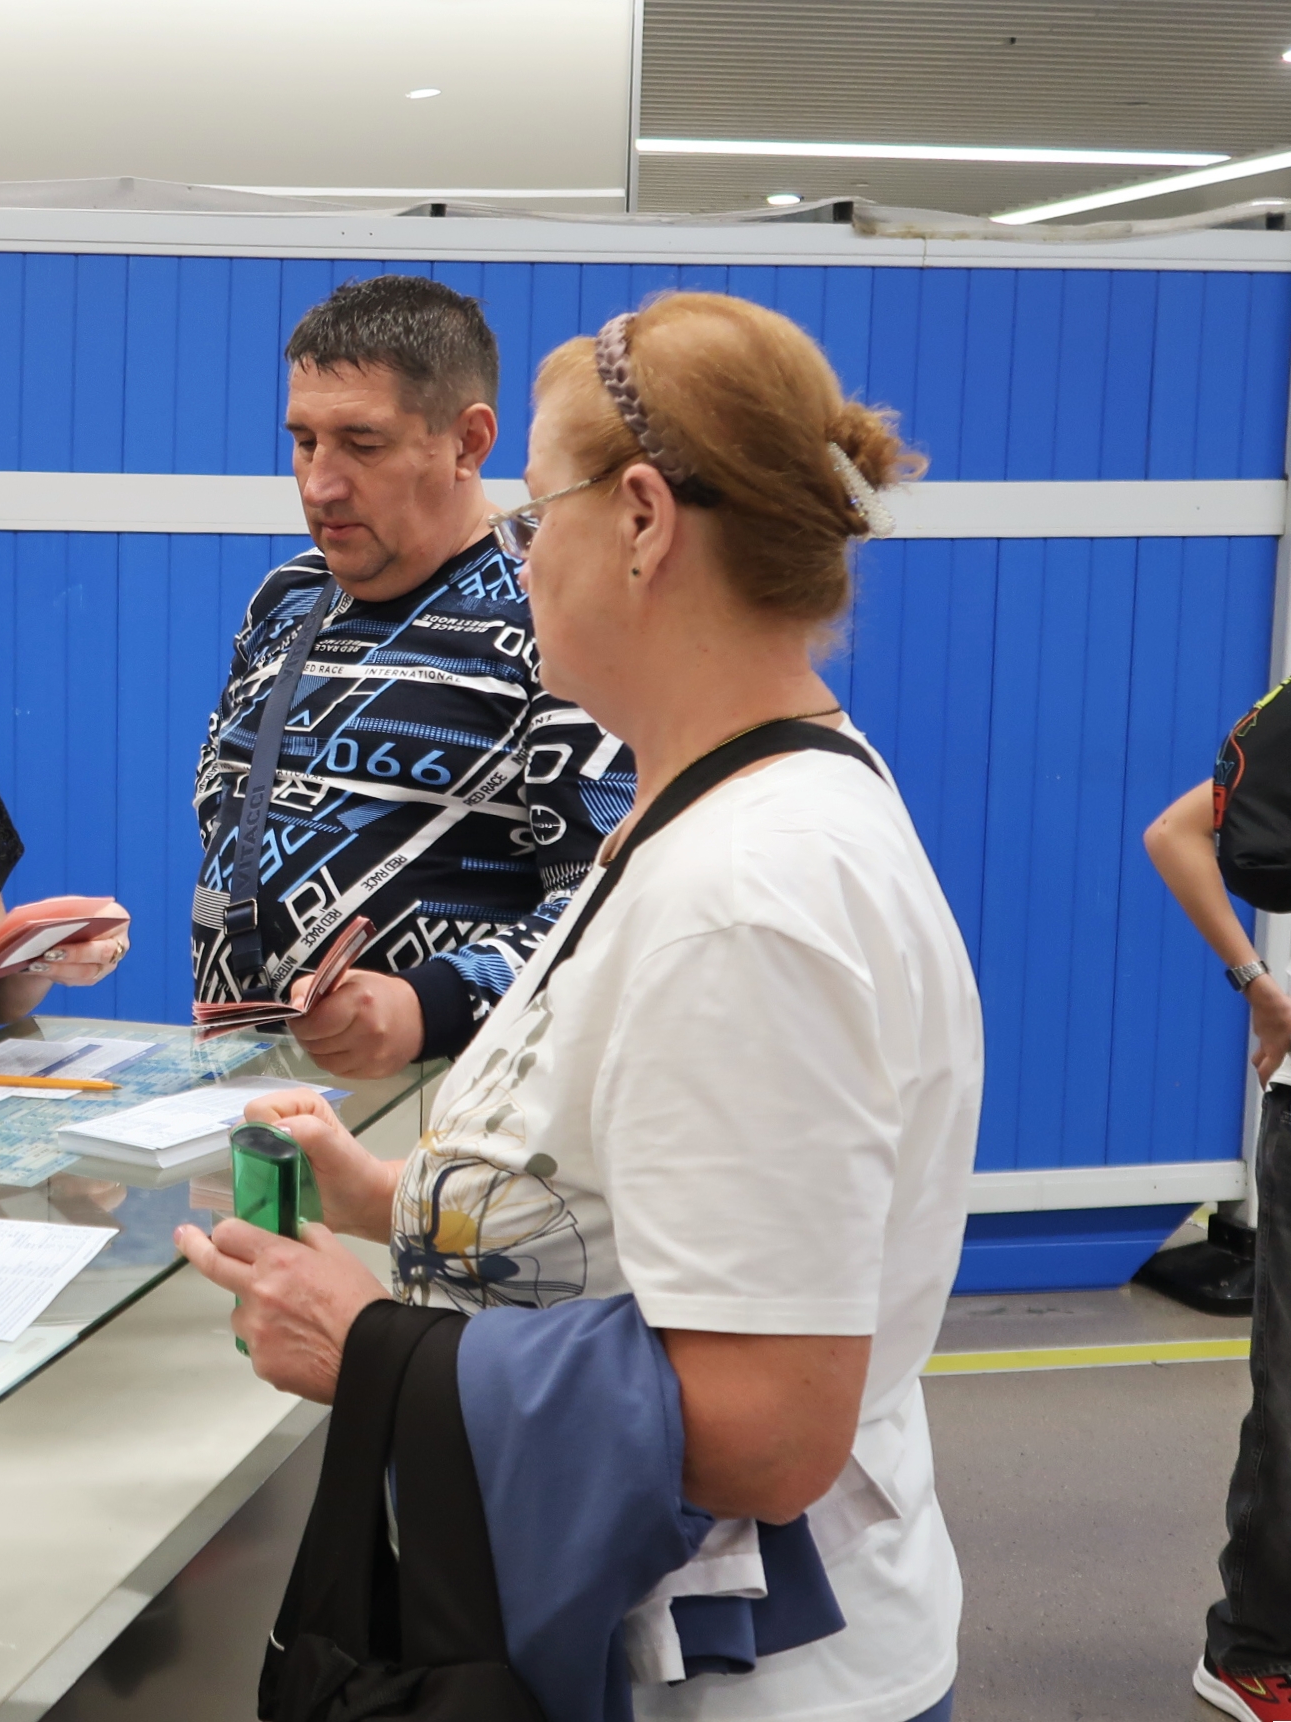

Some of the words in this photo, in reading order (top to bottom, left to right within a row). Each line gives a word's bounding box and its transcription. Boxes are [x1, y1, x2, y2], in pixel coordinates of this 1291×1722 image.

[319, 666, 344, 674] RACE
[325, 737, 451, 787] 066
[463, 789, 487, 806] RED
[483, 771, 508, 795] RACE
[388, 854, 409, 873] RED
[360, 869, 390, 892] RACE
[321, 908, 343, 927] RED
[300, 925, 326, 949] RACE
